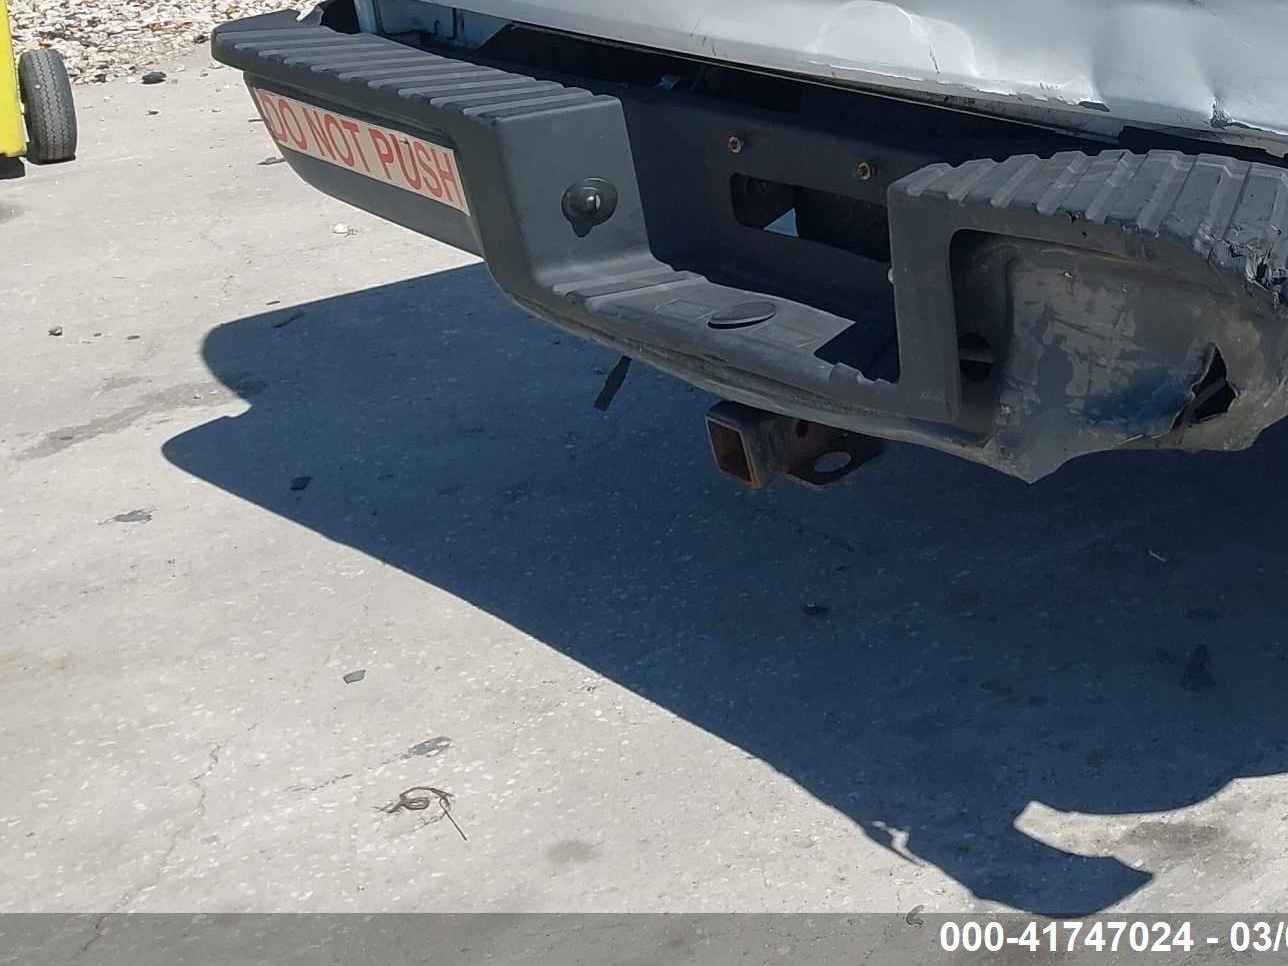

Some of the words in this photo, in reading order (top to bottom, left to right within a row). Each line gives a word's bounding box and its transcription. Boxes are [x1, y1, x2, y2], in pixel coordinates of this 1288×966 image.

[259, 95, 309, 152] DO
[302, 107, 371, 173] NOT
[368, 127, 465, 207] PUSH
